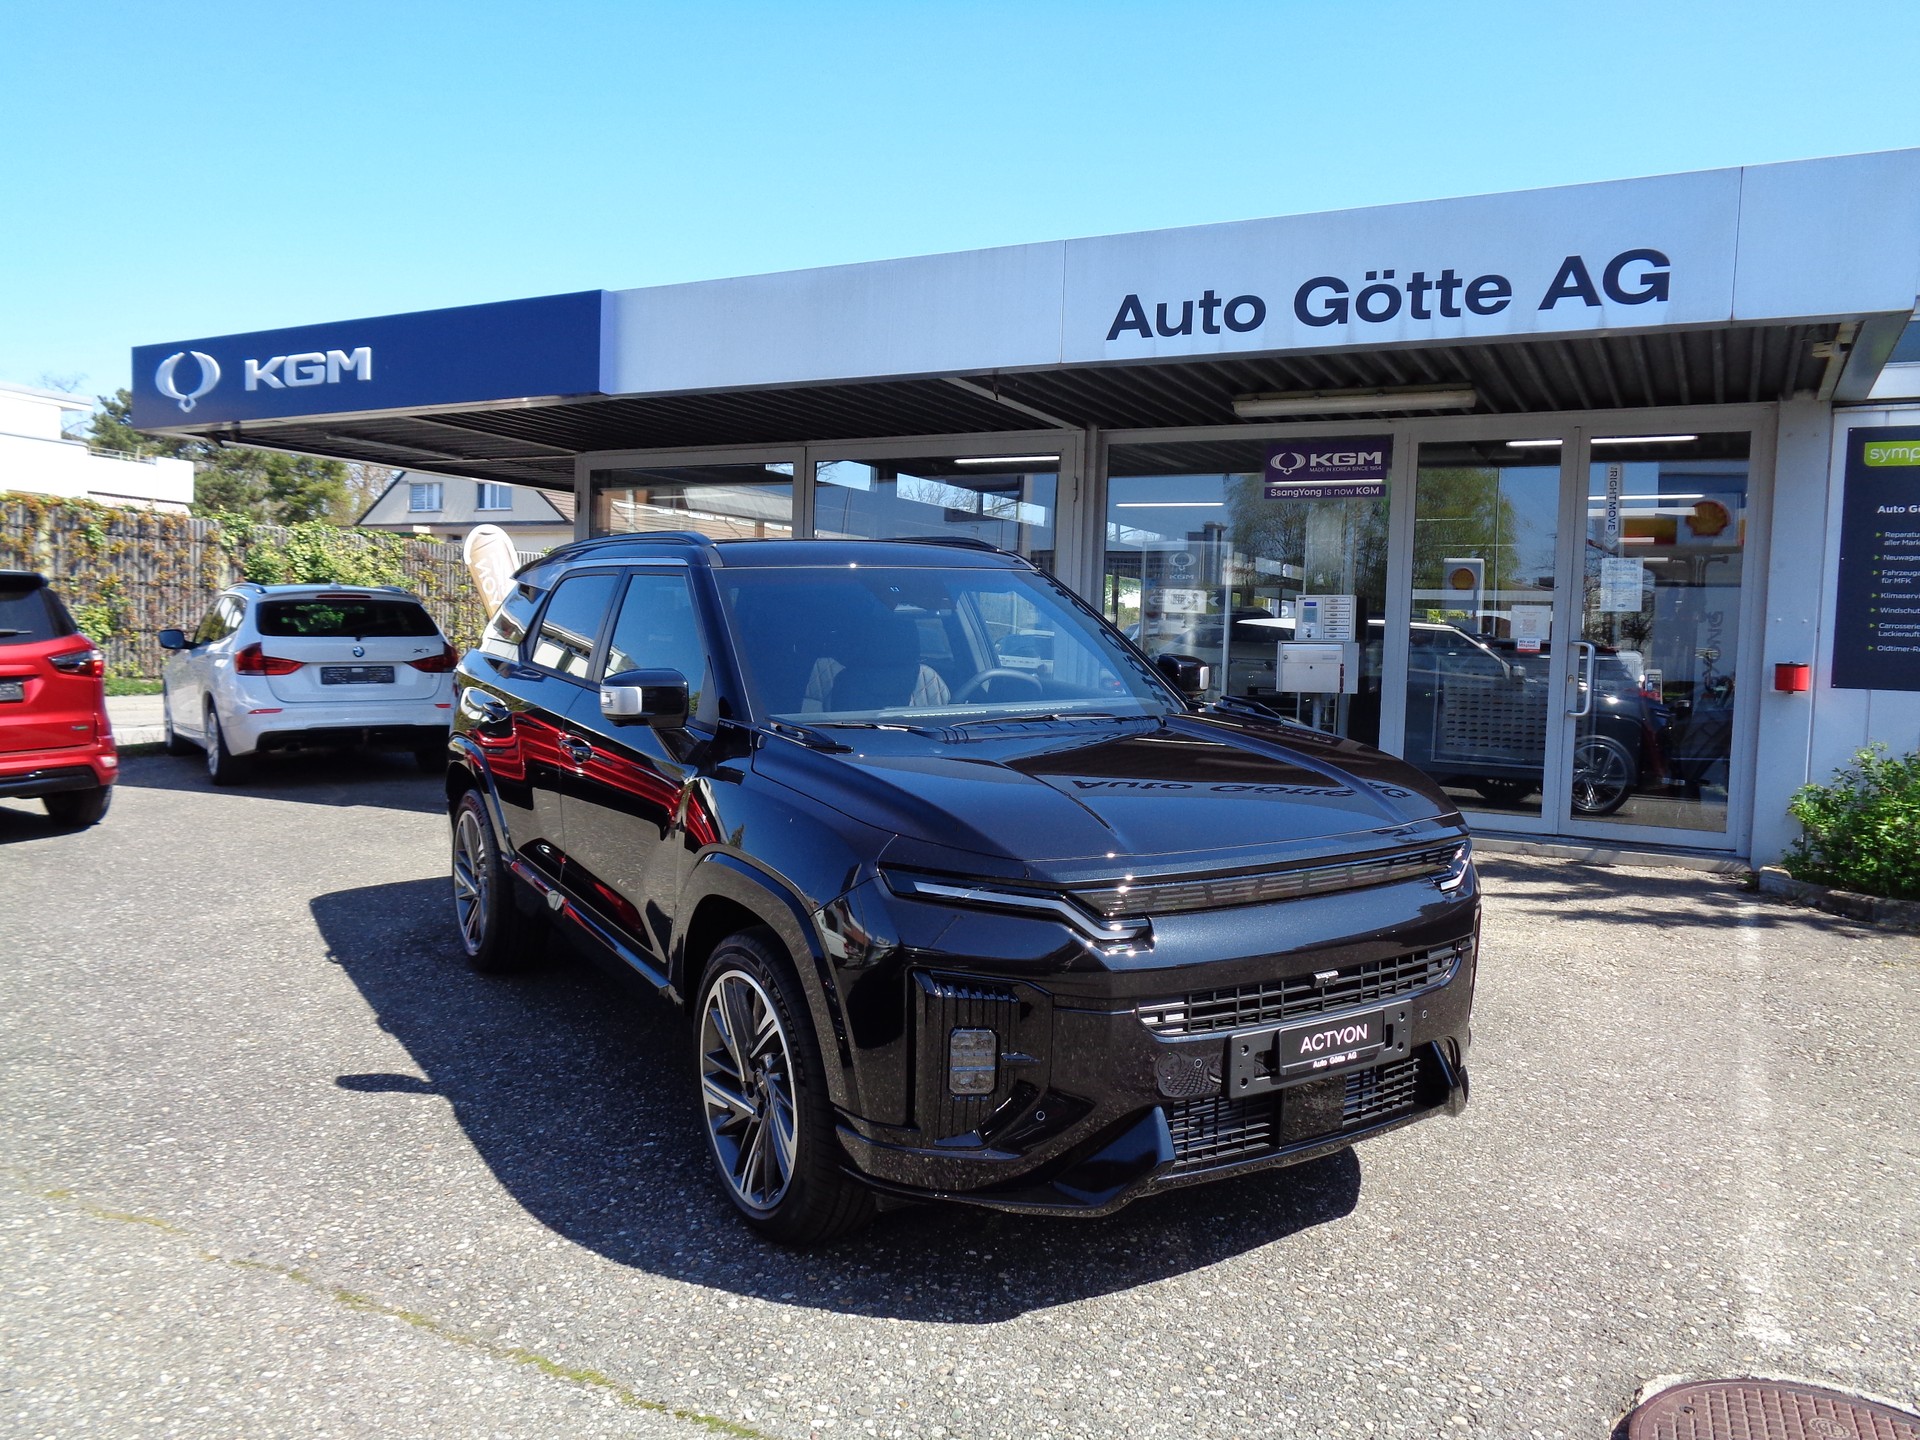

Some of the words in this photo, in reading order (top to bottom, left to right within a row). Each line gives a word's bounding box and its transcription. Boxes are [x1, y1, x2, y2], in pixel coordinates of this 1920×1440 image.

[1105, 289, 1267, 341] Auto
[1293, 269, 1512, 327] Götte
[1537, 248, 1671, 311] AG
[244, 346, 372, 391] KGM
[1310, 452, 1382, 466] KGM
[1270, 488, 1322, 498] SsangYong
[1324, 488, 1332, 496] is
[1334, 488, 1354, 496] now
[1356, 486, 1380, 495] KGM
[1609, 471, 1618, 501] RIGHT
[1608, 501, 1617, 531] MOVE
[1877, 505, 1906, 513] Auto
[1300, 1023, 1368, 1053] ACTYON
[1313, 1060, 1328, 1068] Auto
[1347, 1052, 1357, 1060] AG
